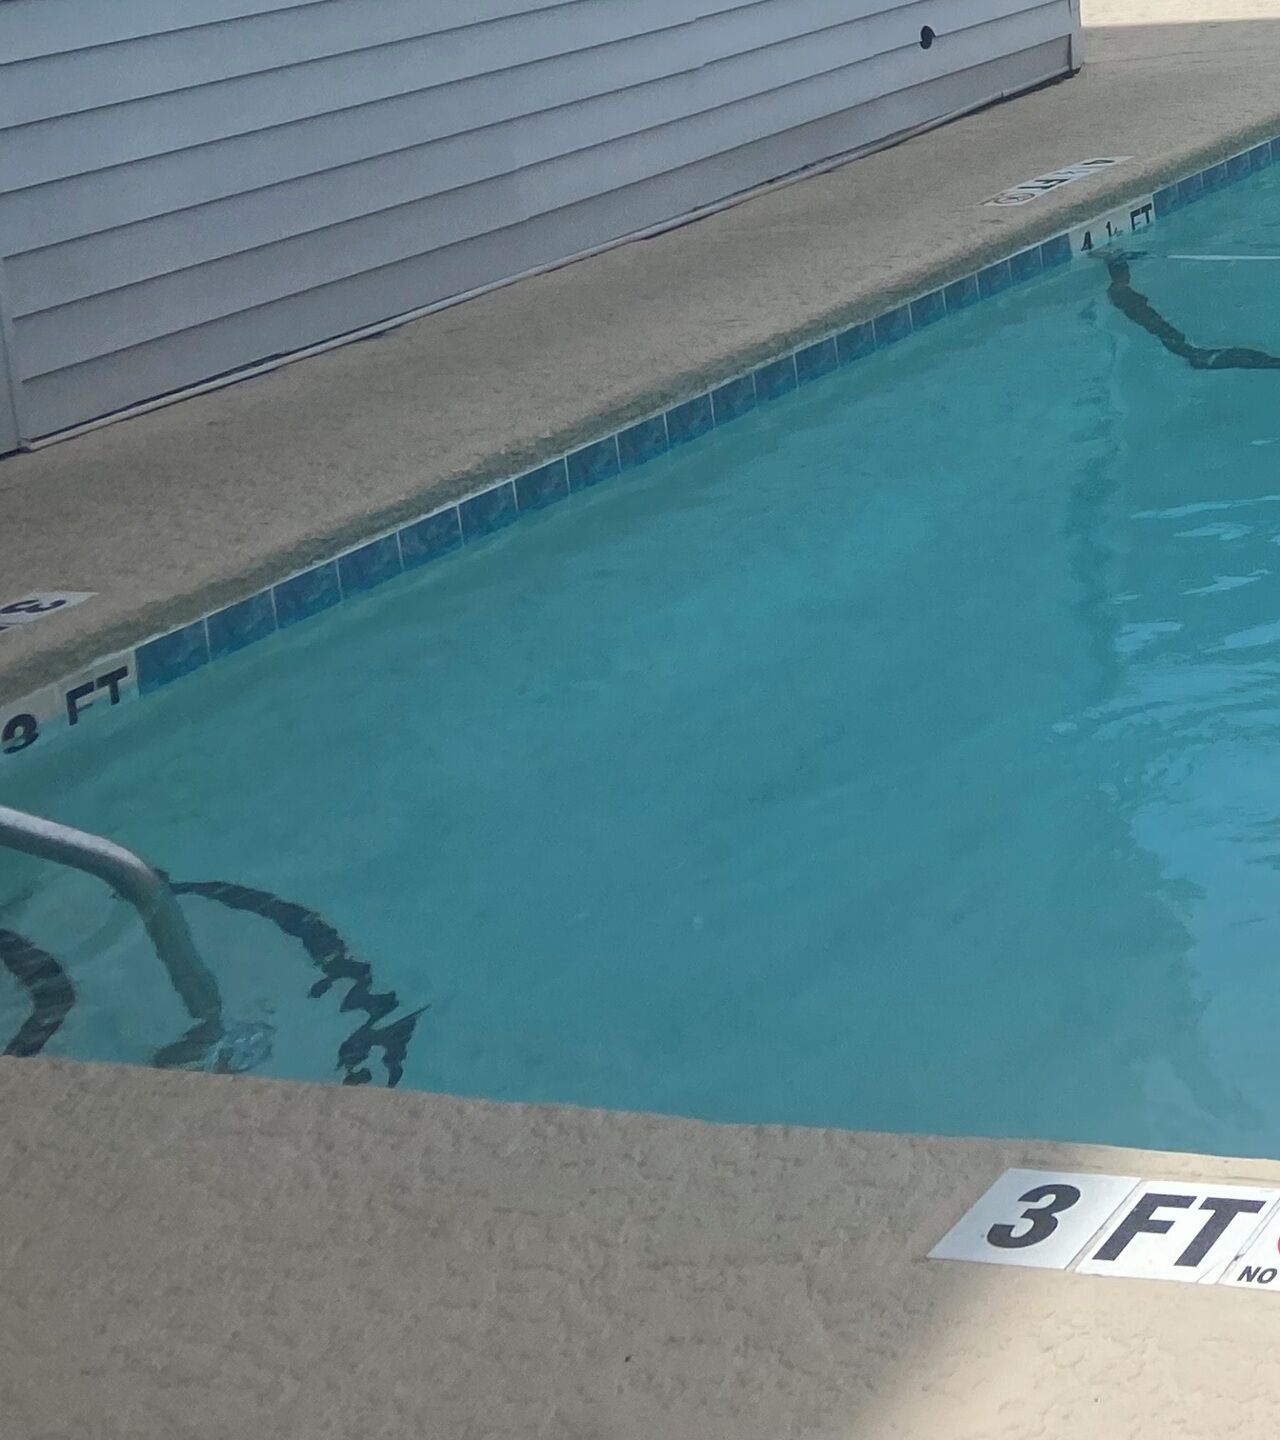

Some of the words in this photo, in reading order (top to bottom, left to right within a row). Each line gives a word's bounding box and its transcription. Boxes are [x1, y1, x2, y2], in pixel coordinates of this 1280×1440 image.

[0, 599, 67, 615] 3
[66, 665, 129, 725] FT
[986, 1183, 1081, 1249] 3
[1092, 1192, 1267, 1268] FT
[1239, 1265, 1277, 1285] NO
